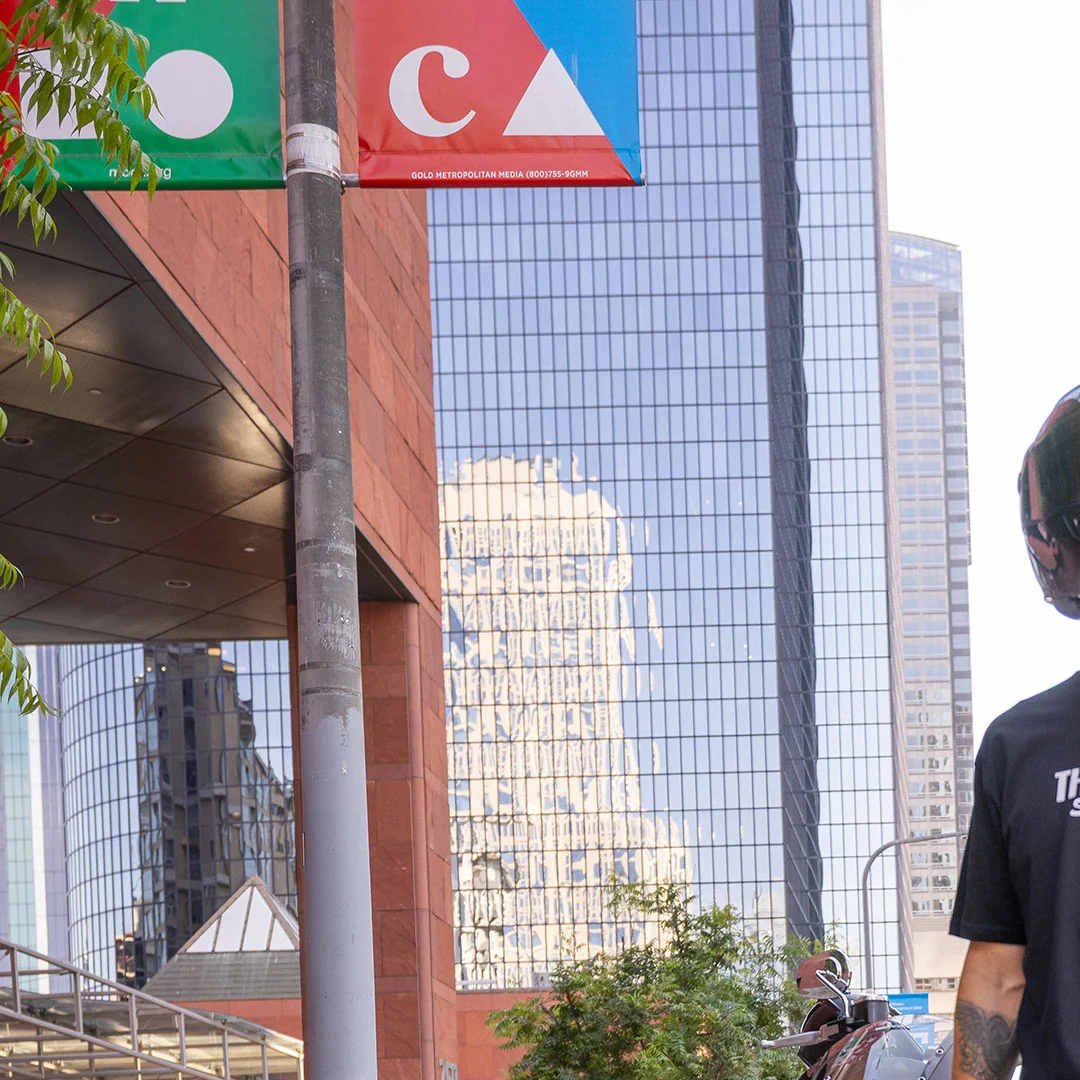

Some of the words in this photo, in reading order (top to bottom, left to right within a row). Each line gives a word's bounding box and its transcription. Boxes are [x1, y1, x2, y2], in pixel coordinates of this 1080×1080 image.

[411, 171, 434, 180] GOLD
[435, 171, 497, 179] METROPOLITAN
[498, 170, 524, 179] MEDIA
